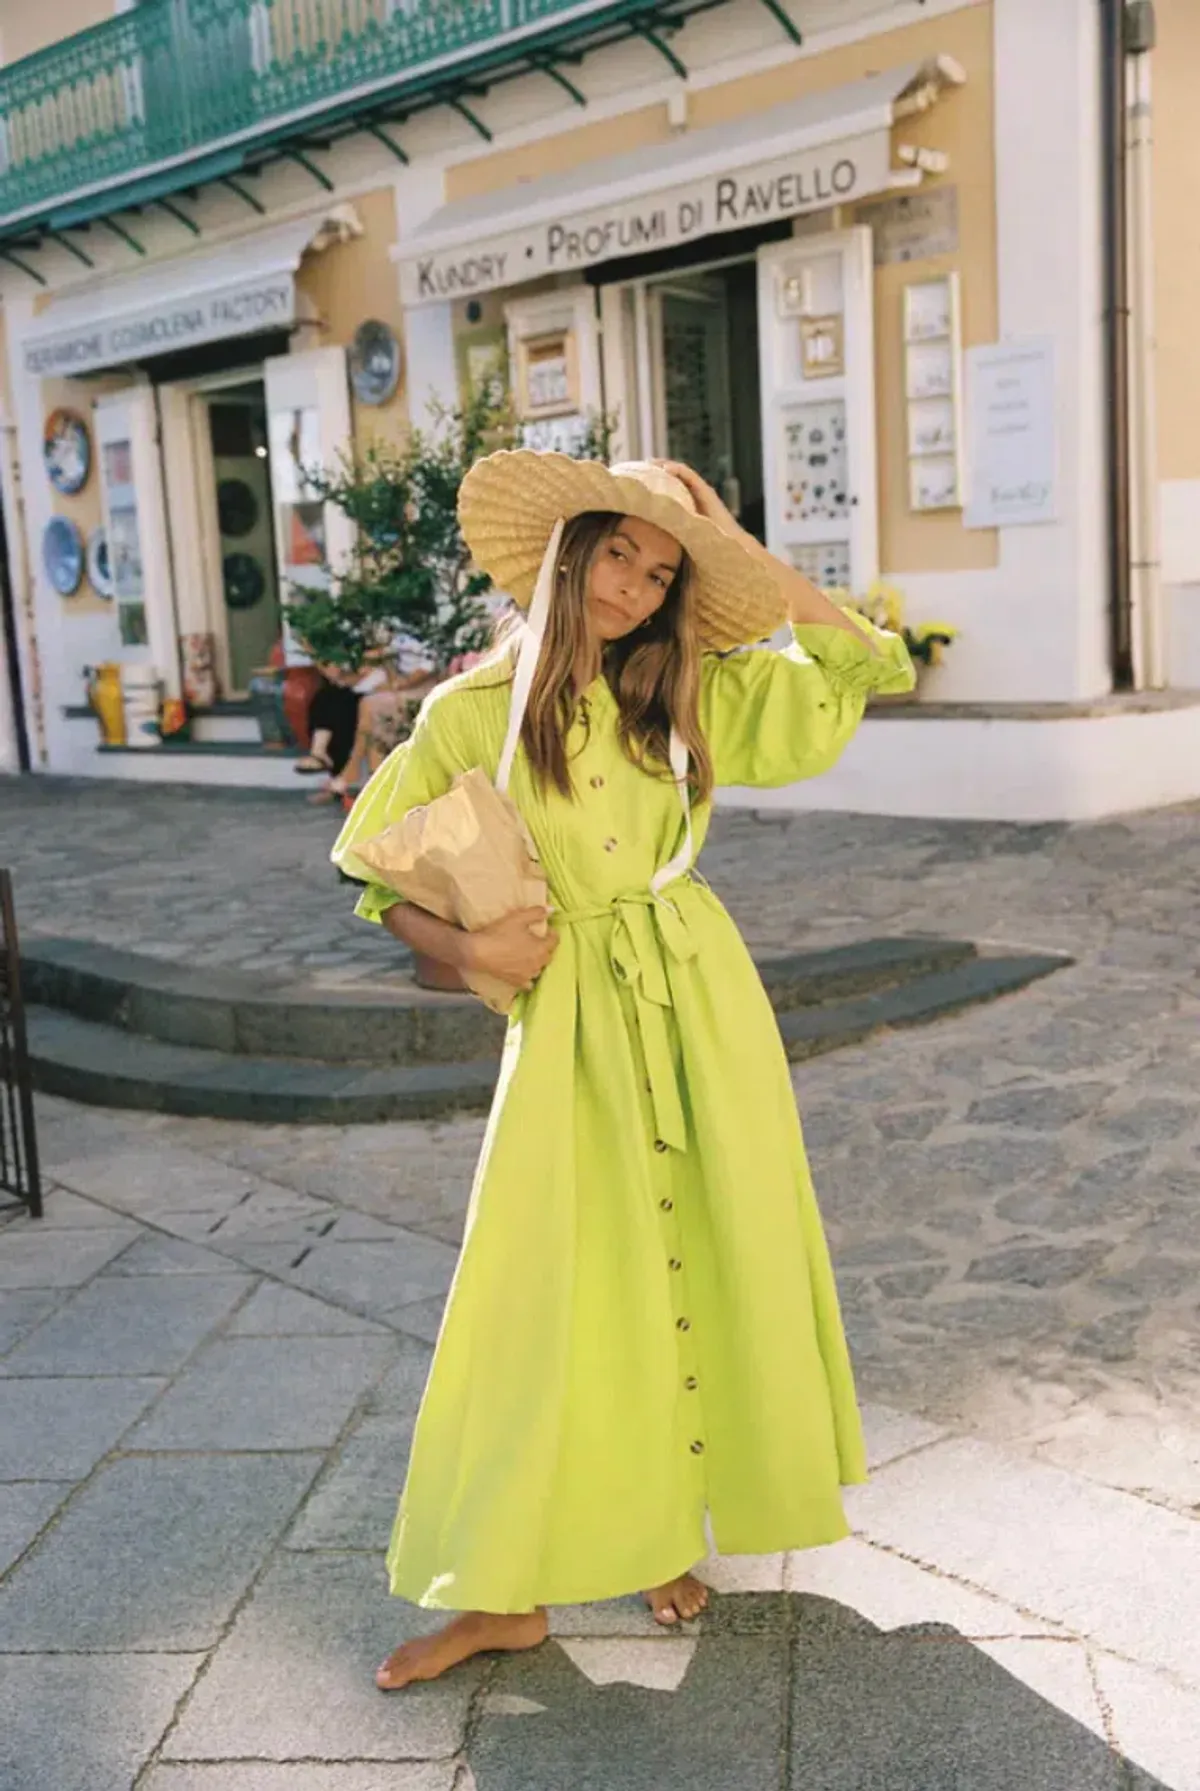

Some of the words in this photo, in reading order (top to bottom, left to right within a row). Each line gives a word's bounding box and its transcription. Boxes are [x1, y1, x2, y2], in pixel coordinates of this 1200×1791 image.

[416, 251, 508, 298] KUNDRY
[548, 209, 666, 266] PROFUMI
[679, 198, 703, 234] DI
[716, 159, 857, 222] RAVELLO
